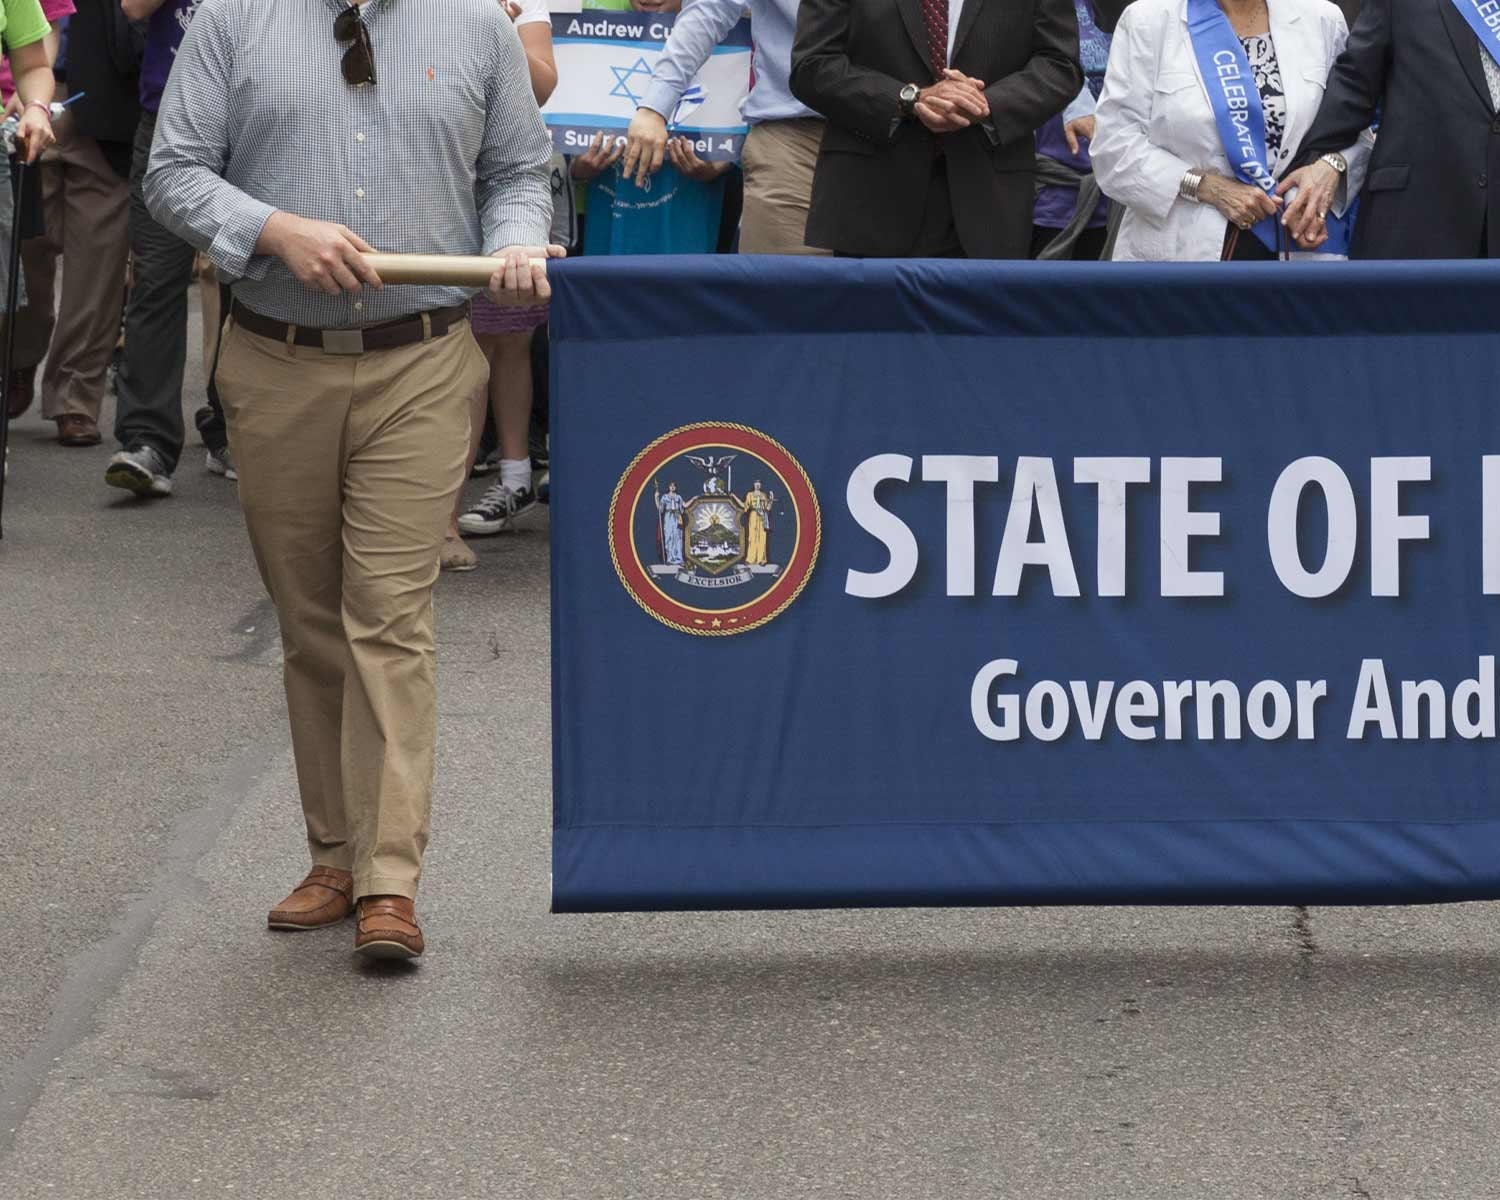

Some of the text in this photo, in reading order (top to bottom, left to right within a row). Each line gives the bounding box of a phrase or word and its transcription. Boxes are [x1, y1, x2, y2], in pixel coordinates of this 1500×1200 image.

[567, 18, 644, 39] Andrew
[1213, 49, 1256, 159] CELEBRATE
[845, 454, 1224, 598] STATE
[1268, 456, 1431, 598] OF
[687, 575, 743, 587] EXCELSIOR
[970, 659, 1327, 742] Governor
